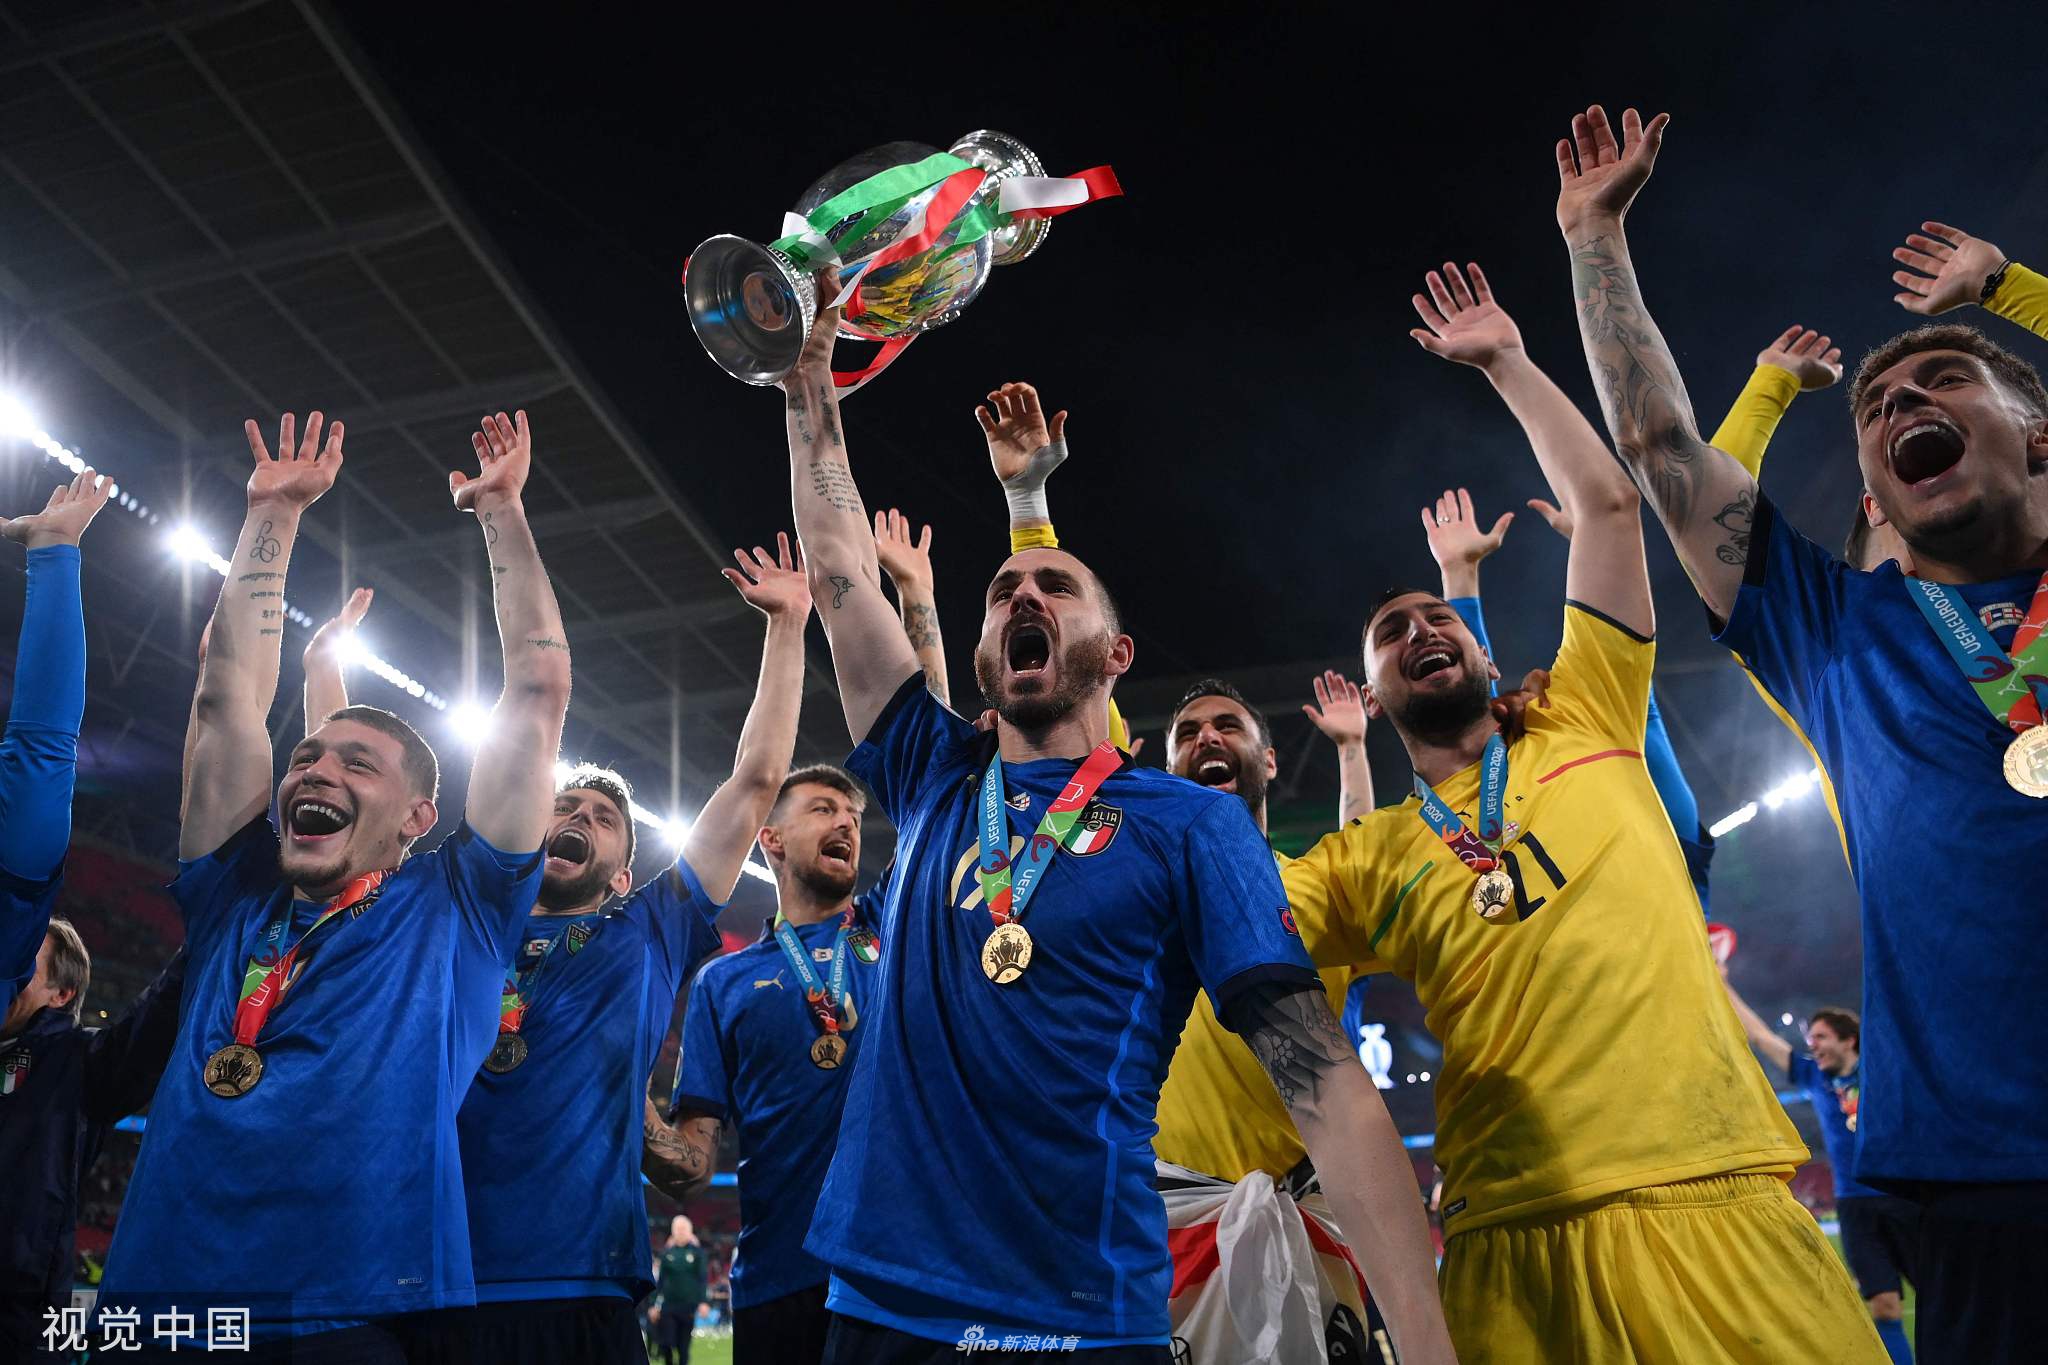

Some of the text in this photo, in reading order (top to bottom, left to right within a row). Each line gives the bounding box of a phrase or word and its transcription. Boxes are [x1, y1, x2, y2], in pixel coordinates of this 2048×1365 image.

[1952, 623, 1982, 655] UEFA
[986, 768, 1001, 847] UEFA EURO 2020
[1423, 801, 1445, 823] 2020
[1486, 787, 1499, 816] UEFA
[1500, 830, 1567, 922] 21
